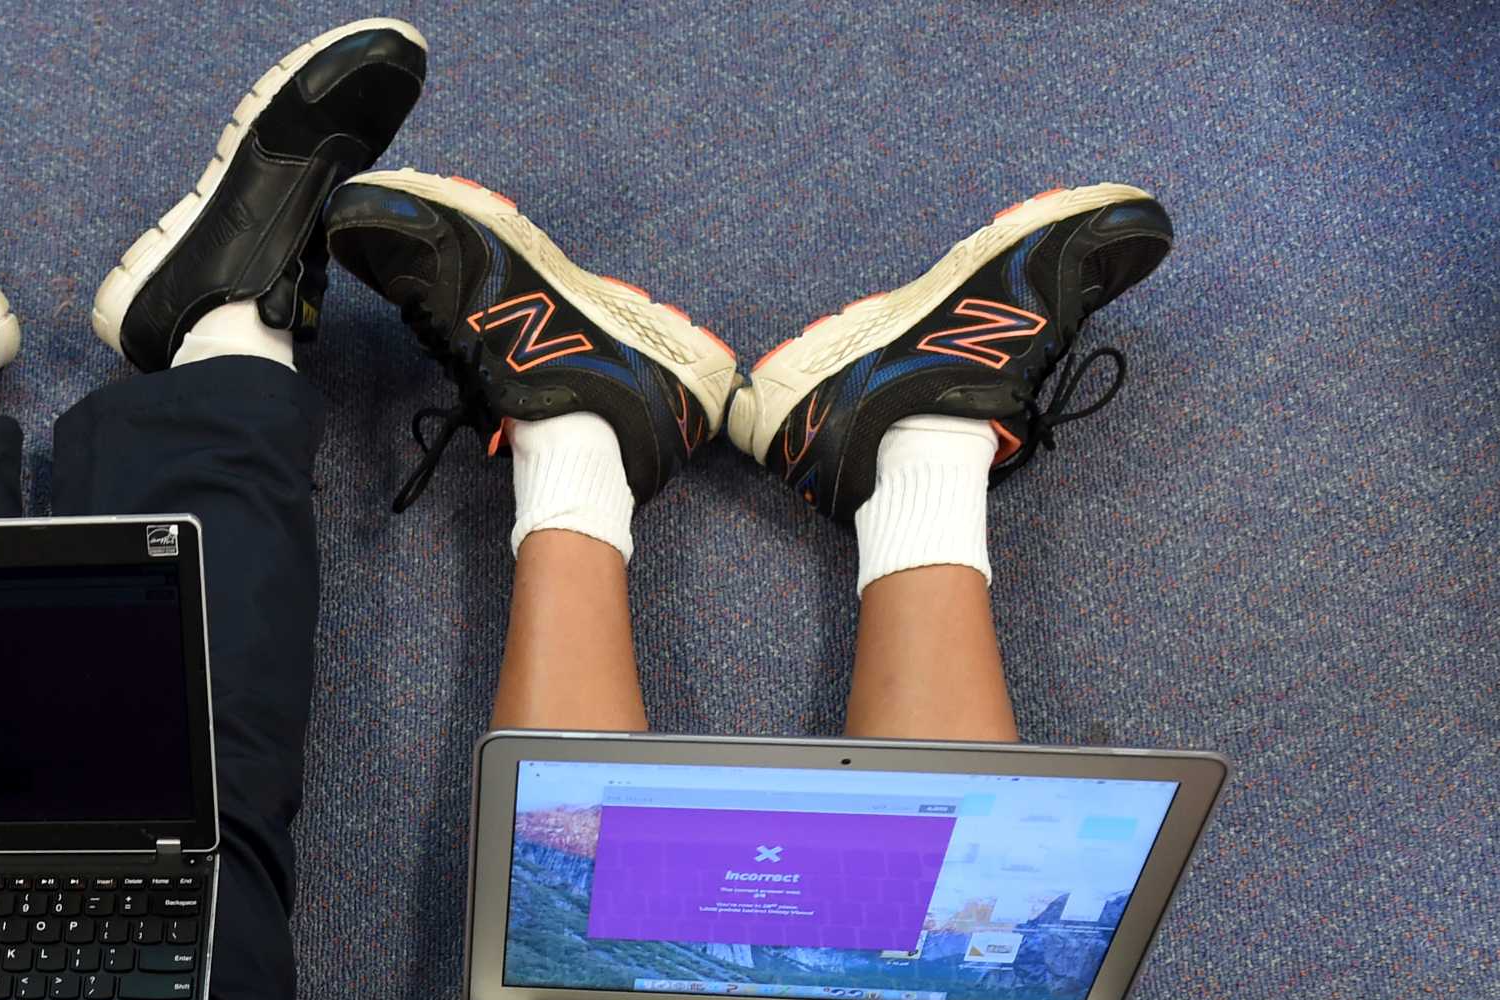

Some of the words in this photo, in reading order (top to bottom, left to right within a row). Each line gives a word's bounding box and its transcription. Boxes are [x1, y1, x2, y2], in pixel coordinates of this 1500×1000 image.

[918, 298, 1048, 371] N
[724, 870, 801, 883] Incorrect
[2, 921, 6, 931] I
[36, 921, 46, 931] O
[69, 921, 78, 931] P
[6, 948, 16, 959] K
[40, 948, 48, 959] L
